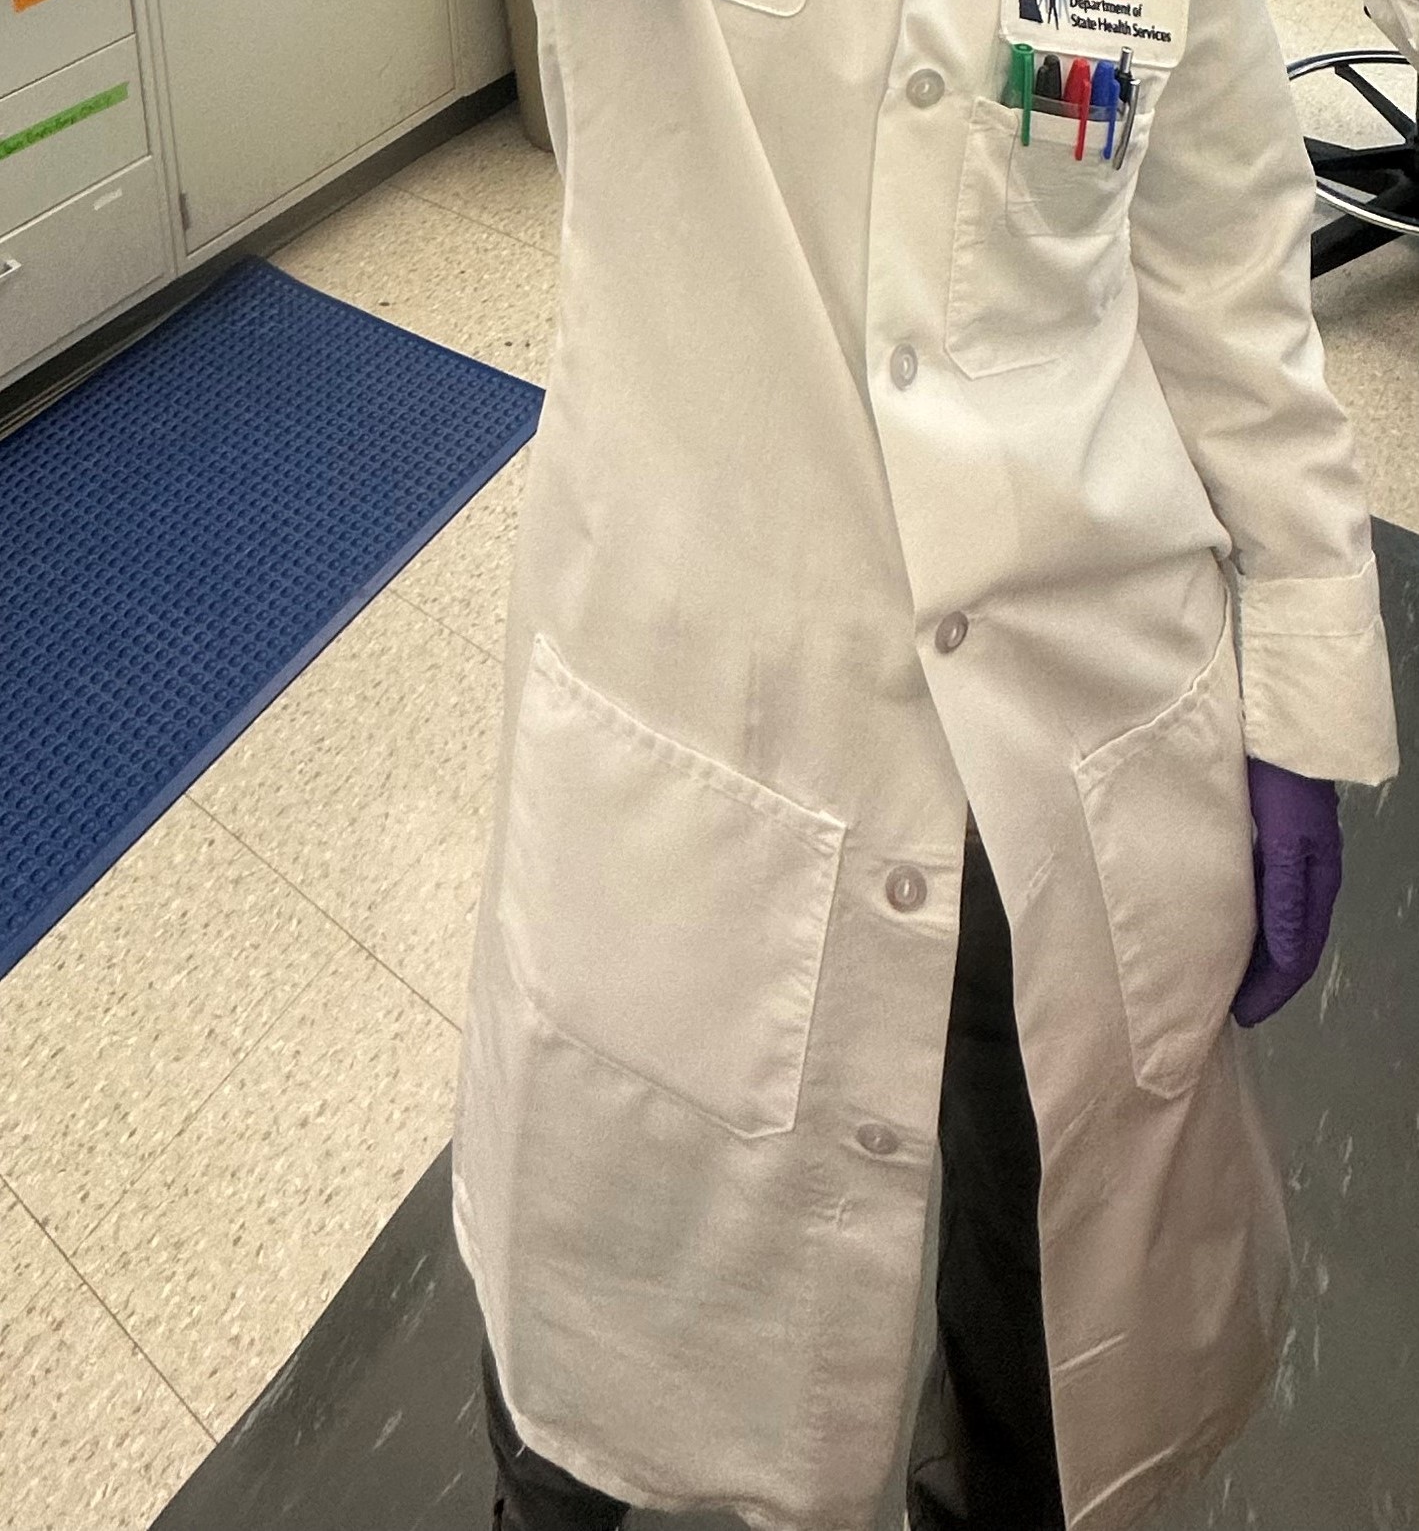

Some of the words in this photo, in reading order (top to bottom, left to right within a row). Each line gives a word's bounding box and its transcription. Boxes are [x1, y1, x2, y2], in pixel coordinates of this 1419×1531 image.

[1132, 3, 1143, 18] of
[1070, 13, 1097, 31] State
[1098, 17, 1132, 36] Health
[1132, 23, 1172, 43] Services
